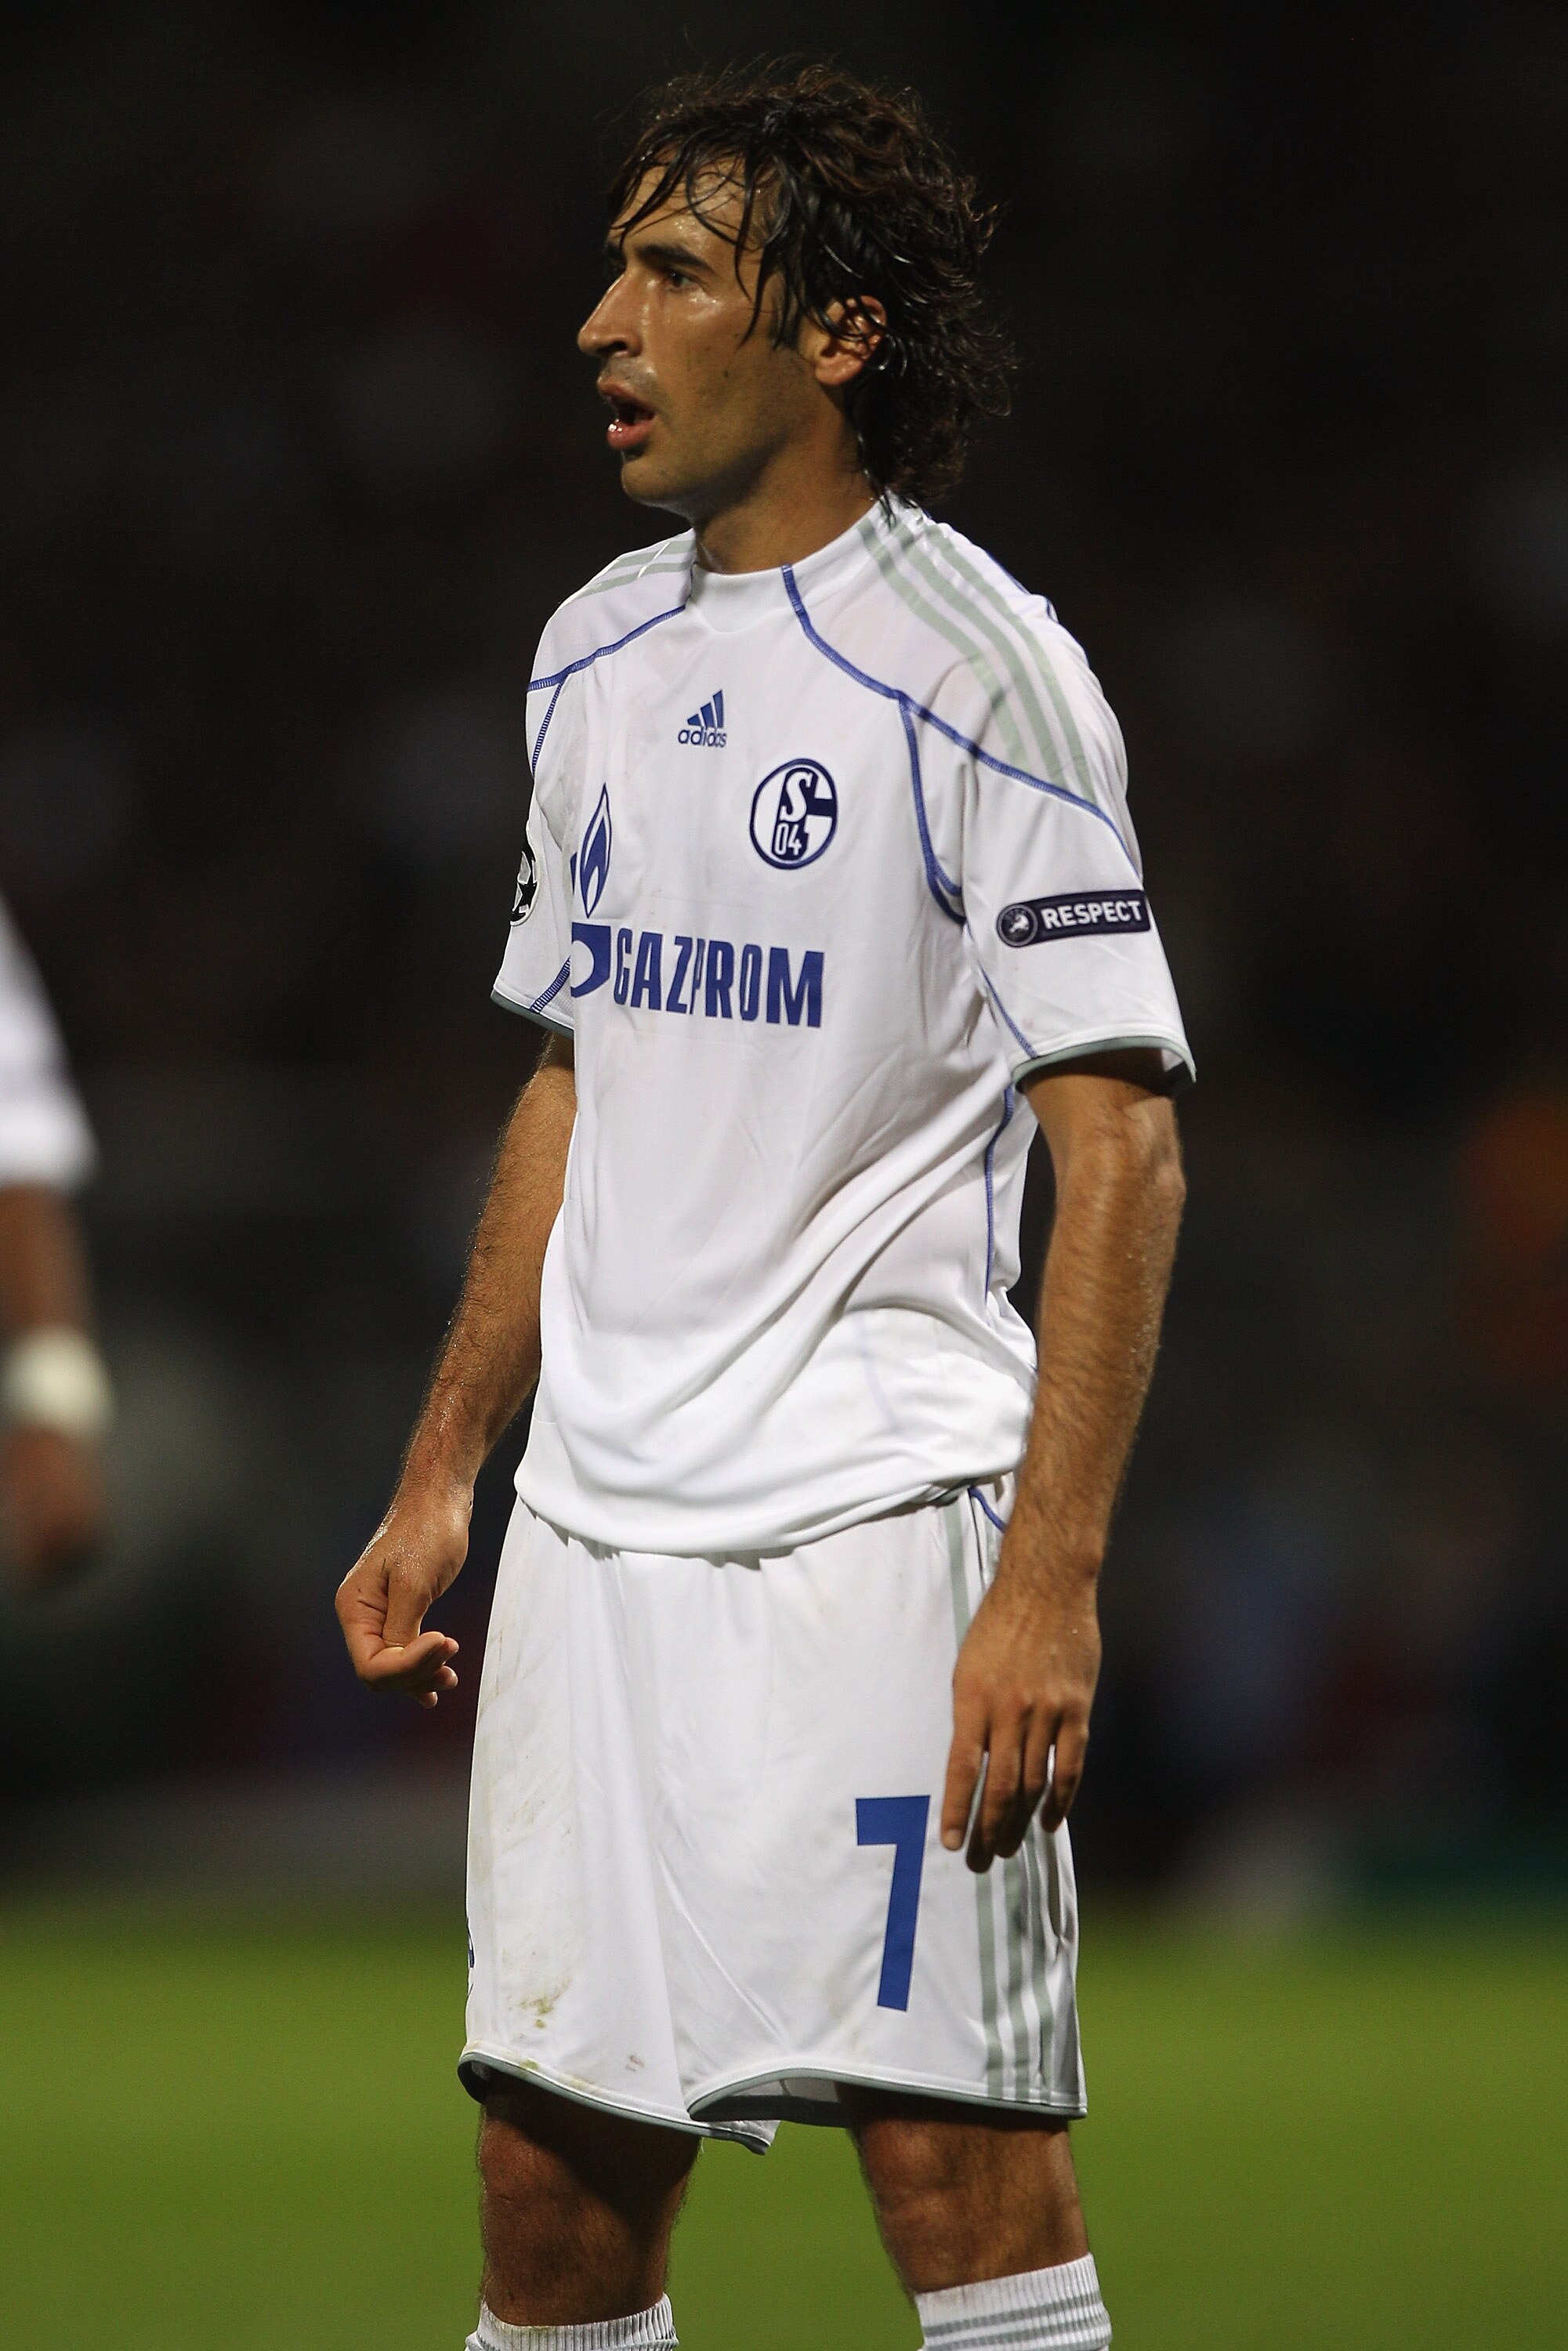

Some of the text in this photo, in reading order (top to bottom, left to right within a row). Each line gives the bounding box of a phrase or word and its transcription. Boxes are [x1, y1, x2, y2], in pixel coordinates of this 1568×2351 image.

[678, 726, 727, 748] adidas
[774, 823, 802, 856] 04
[1041, 900, 1143, 929] RESPECT
[613, 928, 824, 1028] GAZPROM
[855, 1795, 931, 2012] 7
